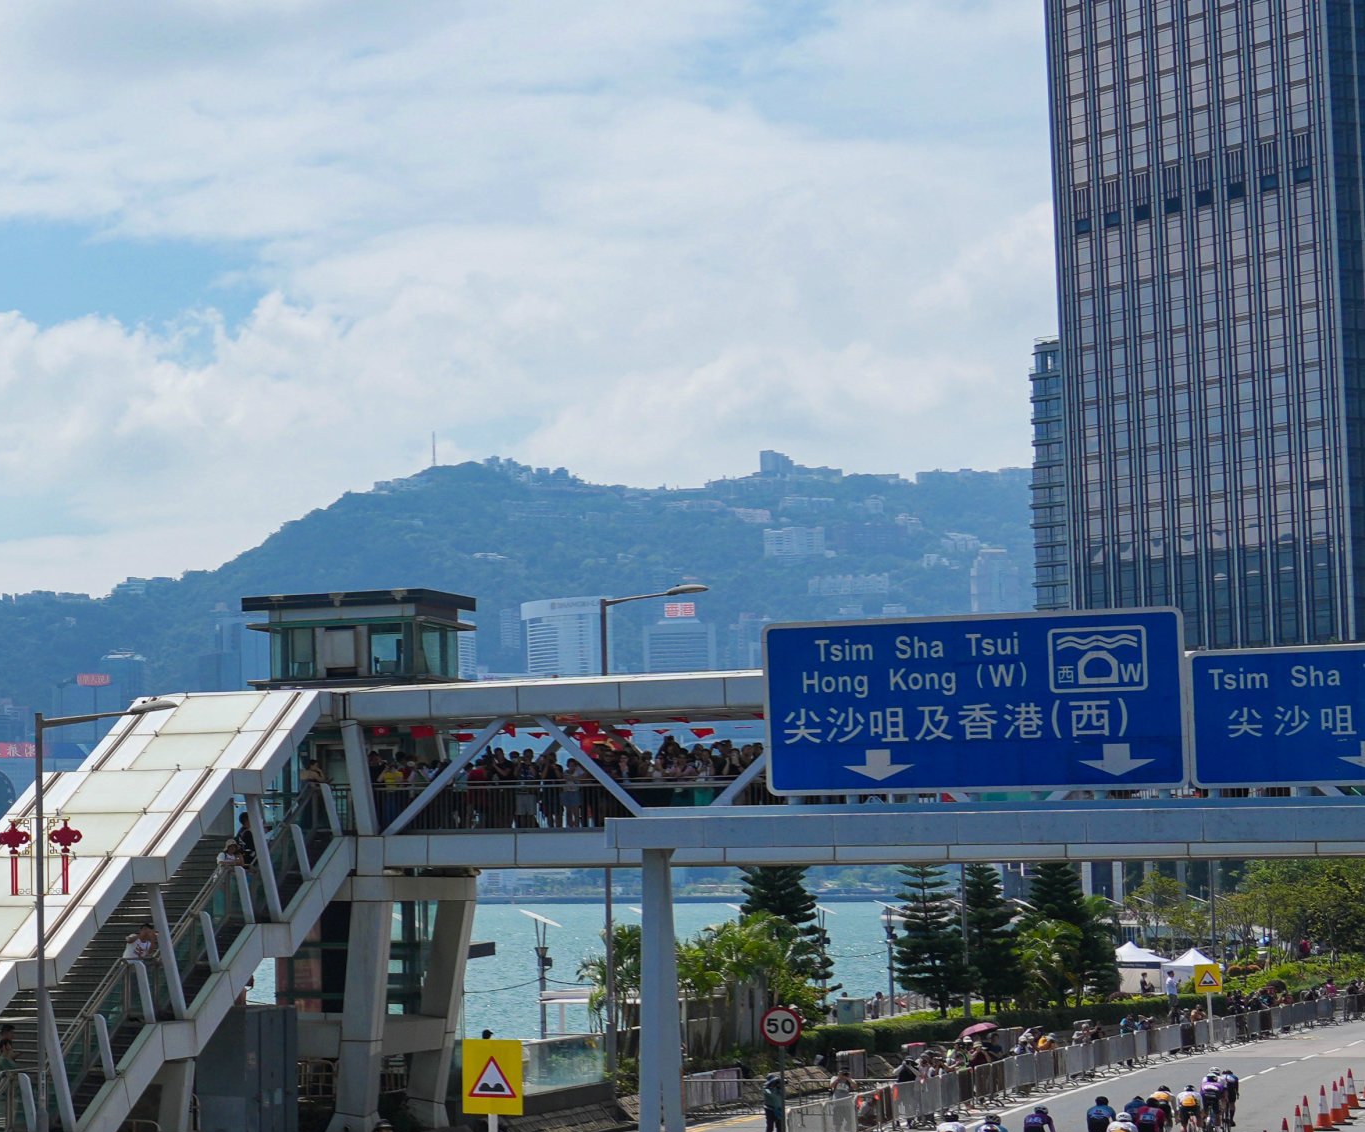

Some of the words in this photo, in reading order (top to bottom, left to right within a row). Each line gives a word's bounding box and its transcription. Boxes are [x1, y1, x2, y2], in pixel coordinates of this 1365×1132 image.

[815, 639, 873, 663] Tsim
[894, 636, 944, 660] Sha
[966, 632, 1020, 658] Tsui
[802, 670, 869, 697] Hong
[889, 667, 957, 695] Kong
[976, 662, 1027, 688] (W)
[1057, 666, 1074, 684] 西
[1120, 663, 1142, 683] W
[1208, 669, 1268, 691] Tsim
[1290, 665, 1340, 688] Sha
[784, 698, 1129, 744] 尖沙咀及香港(西)
[1227, 704, 1357, 738] 尖沙咀
[766, 1018, 796, 1034] 50
